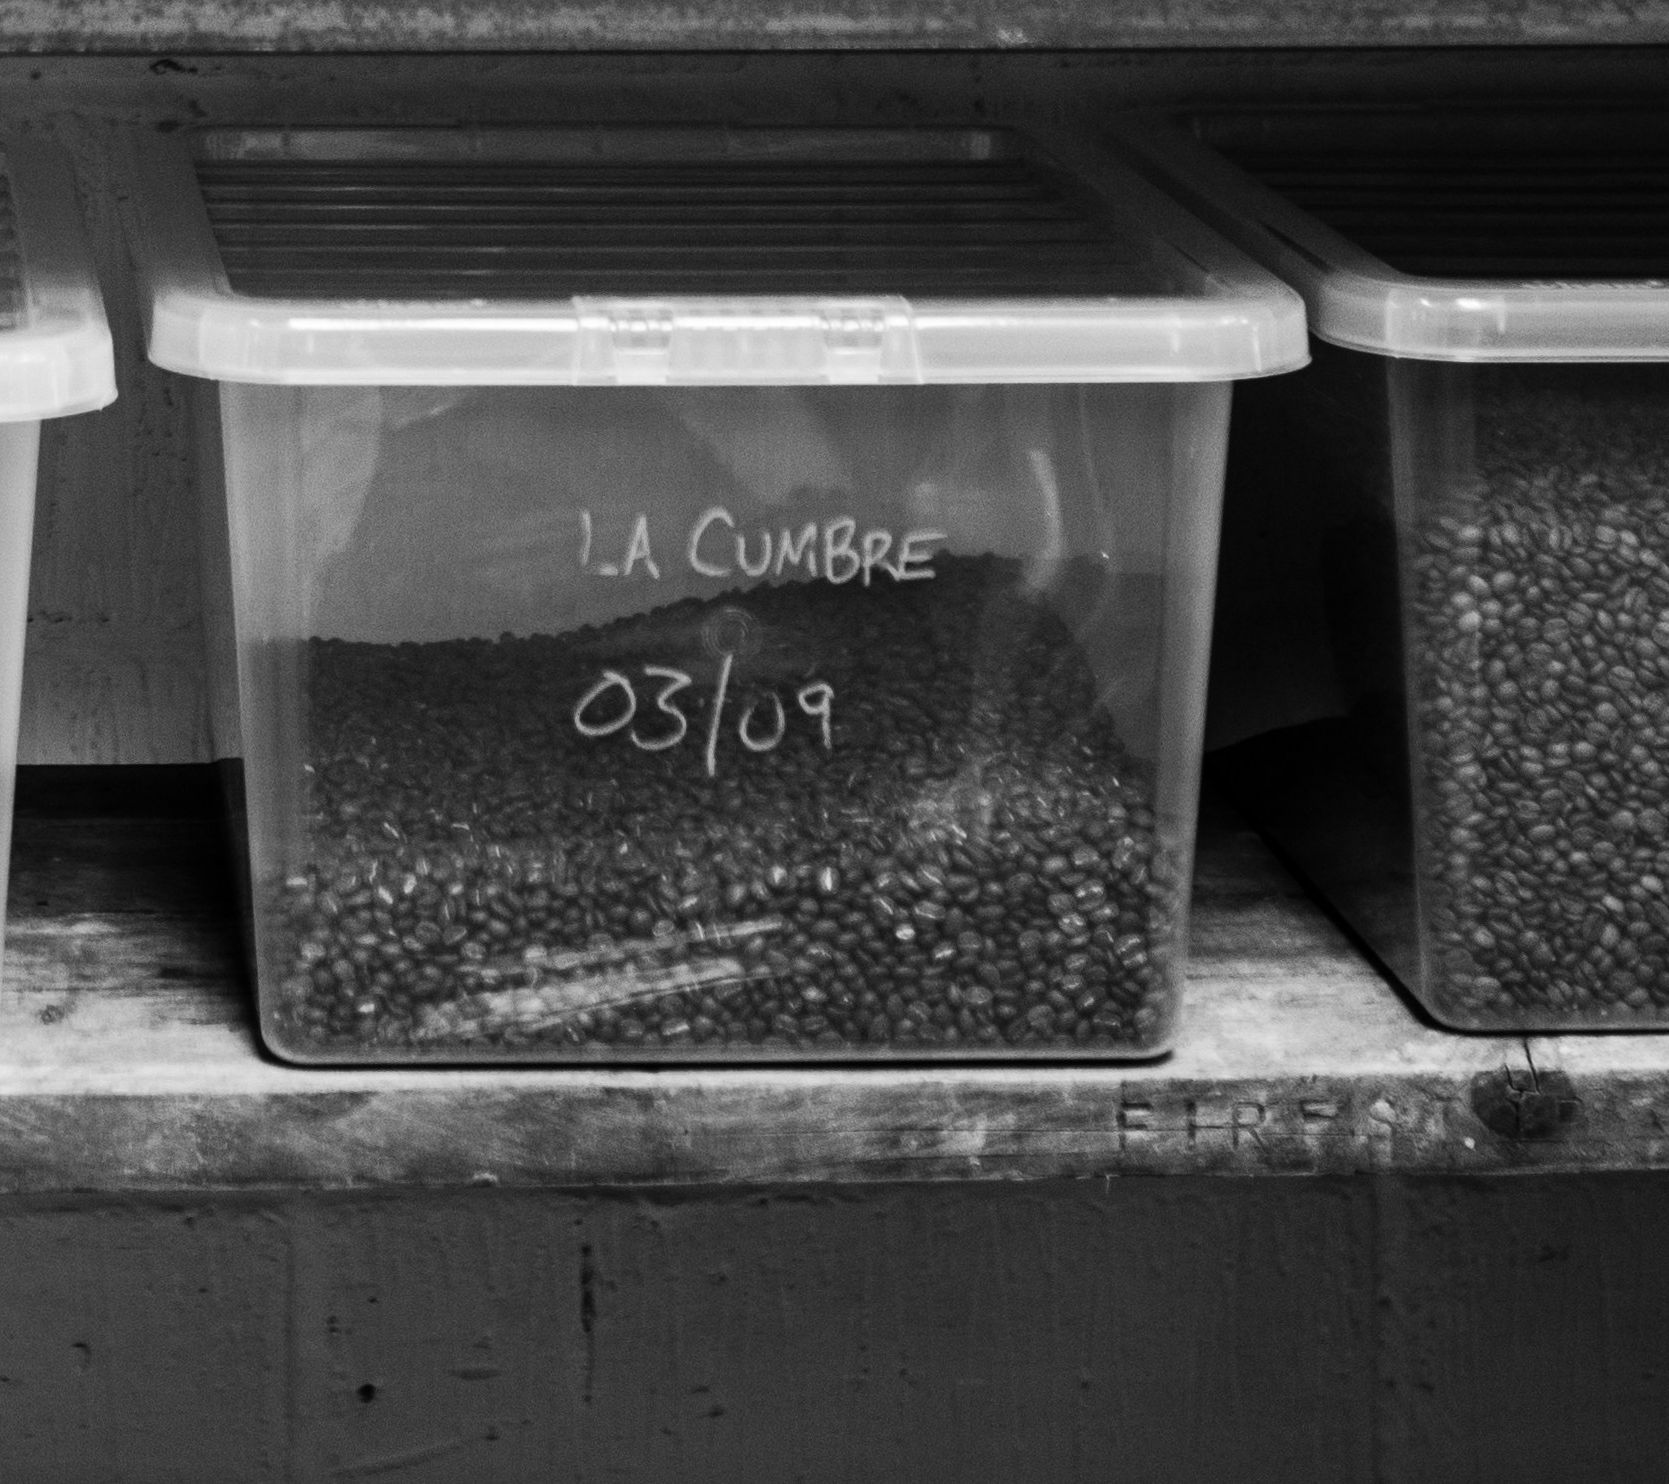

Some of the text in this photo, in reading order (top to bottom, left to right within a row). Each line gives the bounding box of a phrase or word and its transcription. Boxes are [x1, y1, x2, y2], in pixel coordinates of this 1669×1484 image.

[580, 505, 949, 587] LA CUMBRE
[573, 653, 835, 778] 03/09
